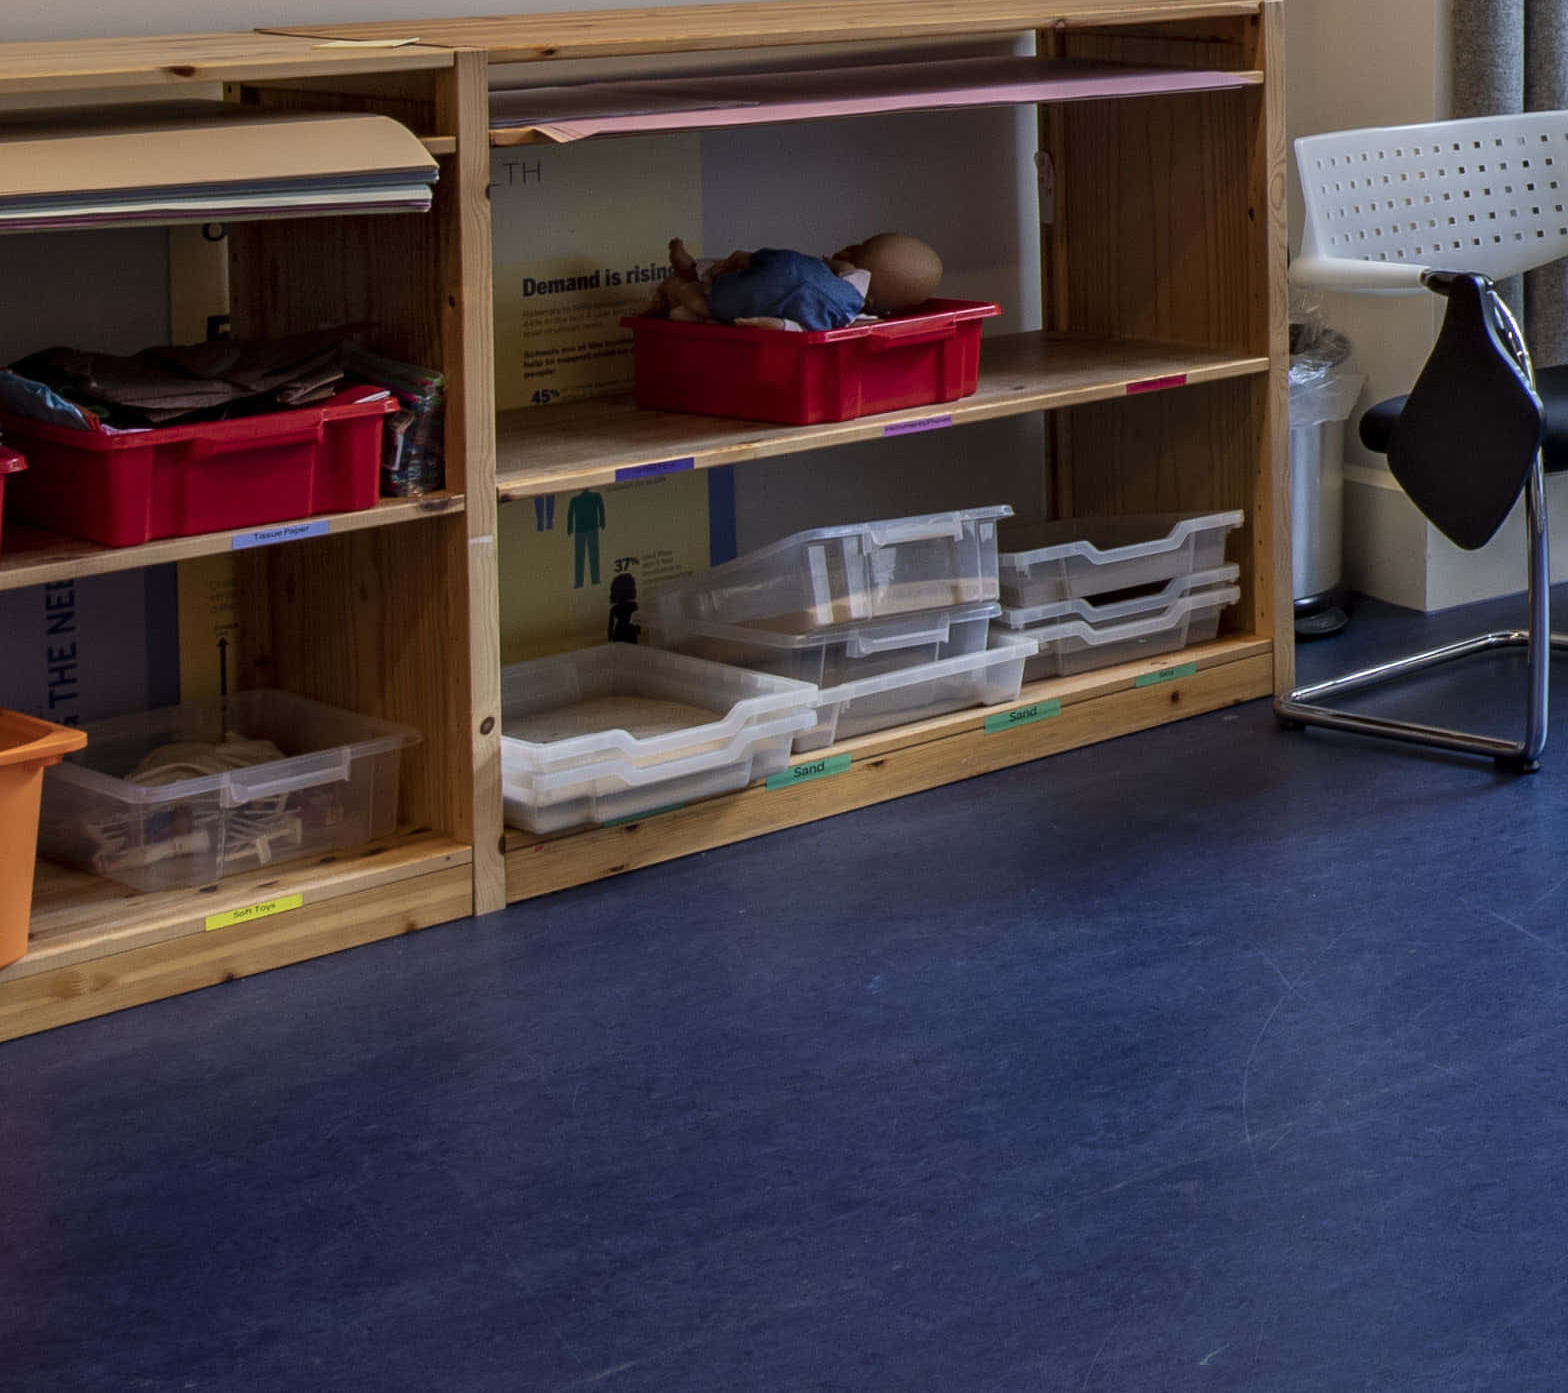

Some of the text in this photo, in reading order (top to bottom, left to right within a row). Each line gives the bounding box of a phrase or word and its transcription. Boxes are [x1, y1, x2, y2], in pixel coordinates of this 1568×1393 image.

[522, 270, 600, 297] Demand
[605, 268, 622, 287] is
[531, 388, 561, 404] 45%
[254, 525, 310, 541] Tissue Paper
[614, 557, 640, 573] 37%
[47, 641, 79, 710] THE
[1008, 705, 1038, 723] Sand
[793, 760, 825, 778] Sand
[233, 903, 276, 918] Soft Toys
